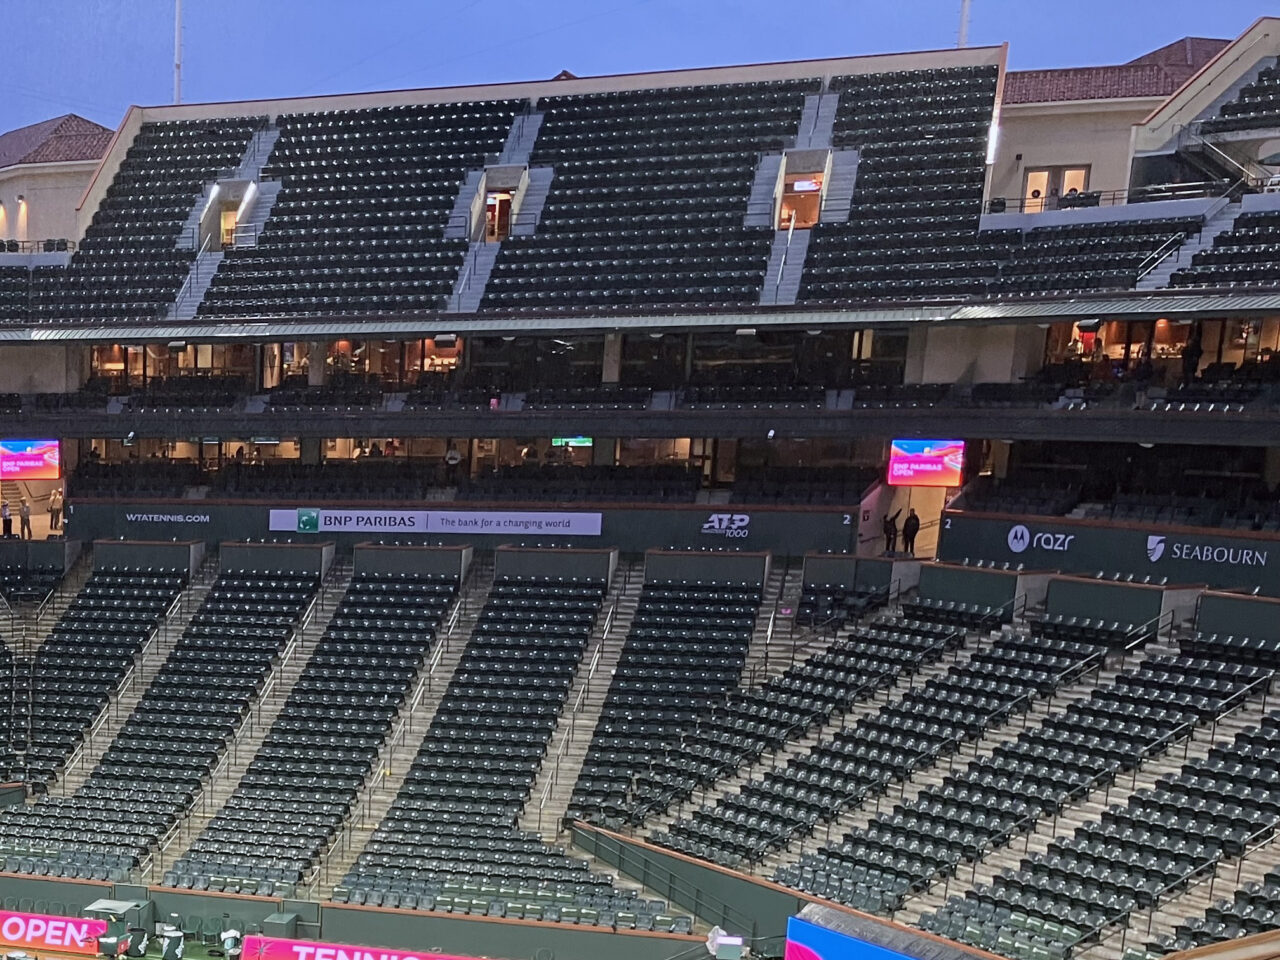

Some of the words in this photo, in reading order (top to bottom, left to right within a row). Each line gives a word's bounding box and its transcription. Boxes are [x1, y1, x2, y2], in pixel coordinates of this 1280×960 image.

[126, 513, 210, 523] WTATENNIS.COM
[323, 515, 353, 526] BNP
[356, 516, 416, 527] PARIBAS
[440, 517, 455, 527] The
[458, 517, 478, 527] bank
[480, 518, 494, 529] for
[504, 518, 543, 530] changing
[545, 519, 571, 528] world
[703, 514, 750, 529] ATP
[843, 515, 851, 524] 2
[944, 519, 952, 529] 2
[726, 530, 748, 538] 1000
[1033, 532, 1075, 551] razr
[1172, 543, 1268, 567] SEABOURN
[1, 916, 88, 947] OPEN
